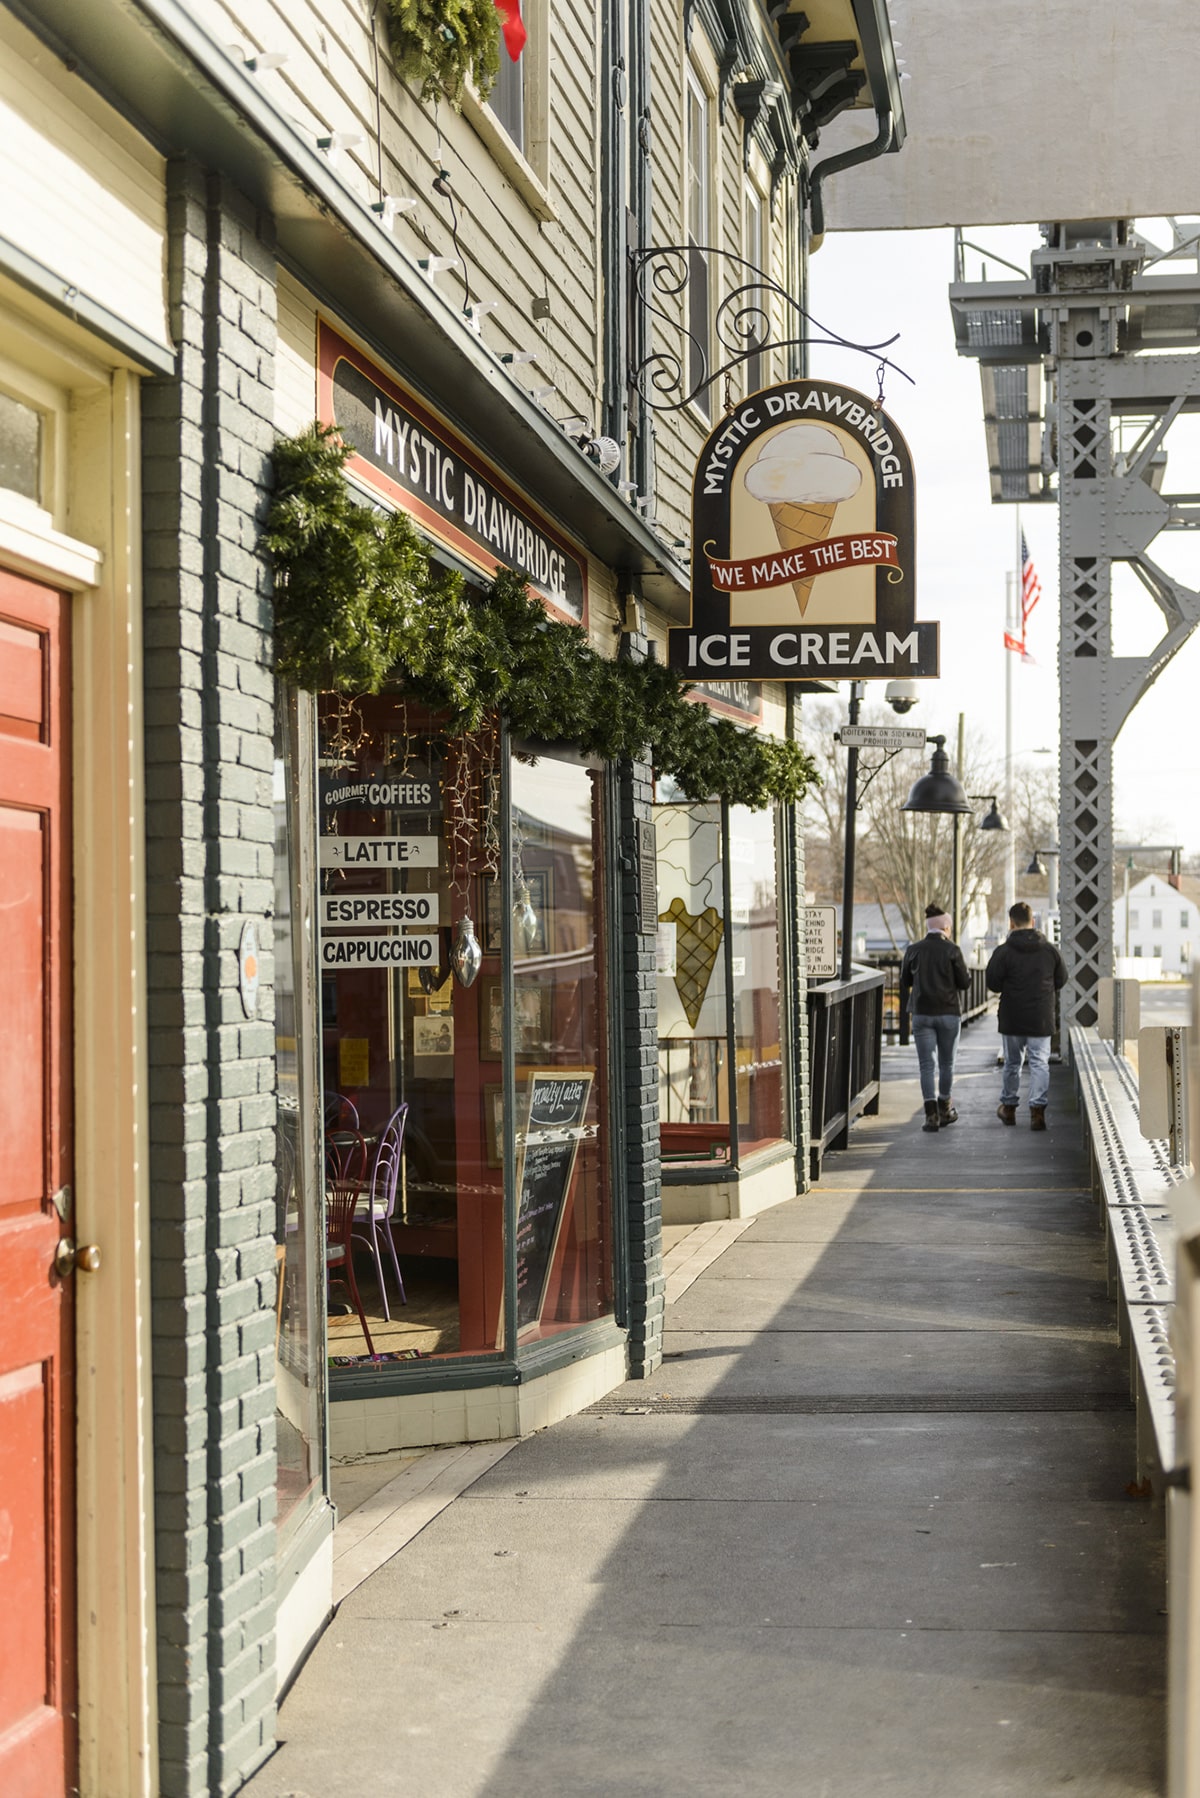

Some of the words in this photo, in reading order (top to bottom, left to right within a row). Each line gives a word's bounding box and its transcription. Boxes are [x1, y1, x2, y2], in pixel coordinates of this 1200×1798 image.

[703, 408, 761, 494] MYSTIC
[764, 390, 903, 489] DRAWBRIDGE
[374, 396, 454, 511] MYSTIC
[463, 471, 566, 600] DRAWBRIDGE
[751, 553, 807, 585] MAKE
[809, 542, 847, 568] THE
[687, 634, 751, 667] ICE
[768, 631, 919, 666] CREAM
[843, 729, 877, 737] LOITERING
[891, 730, 924, 739] SIDEWALK
[863, 737, 903, 746] PROHIBITED
[325, 784, 369, 805] GOURMET
[368, 783, 432, 805] COFFEES
[343, 842, 409, 862] LATTE
[326, 899, 430, 922] ESPRESSO
[804, 911, 822, 919] STAY
[805, 920, 826, 928] EHIND
[323, 939, 433, 963] CAPPUCCINO
[805, 946, 825, 954] RIDGE
[807, 964, 833, 972] RATION
